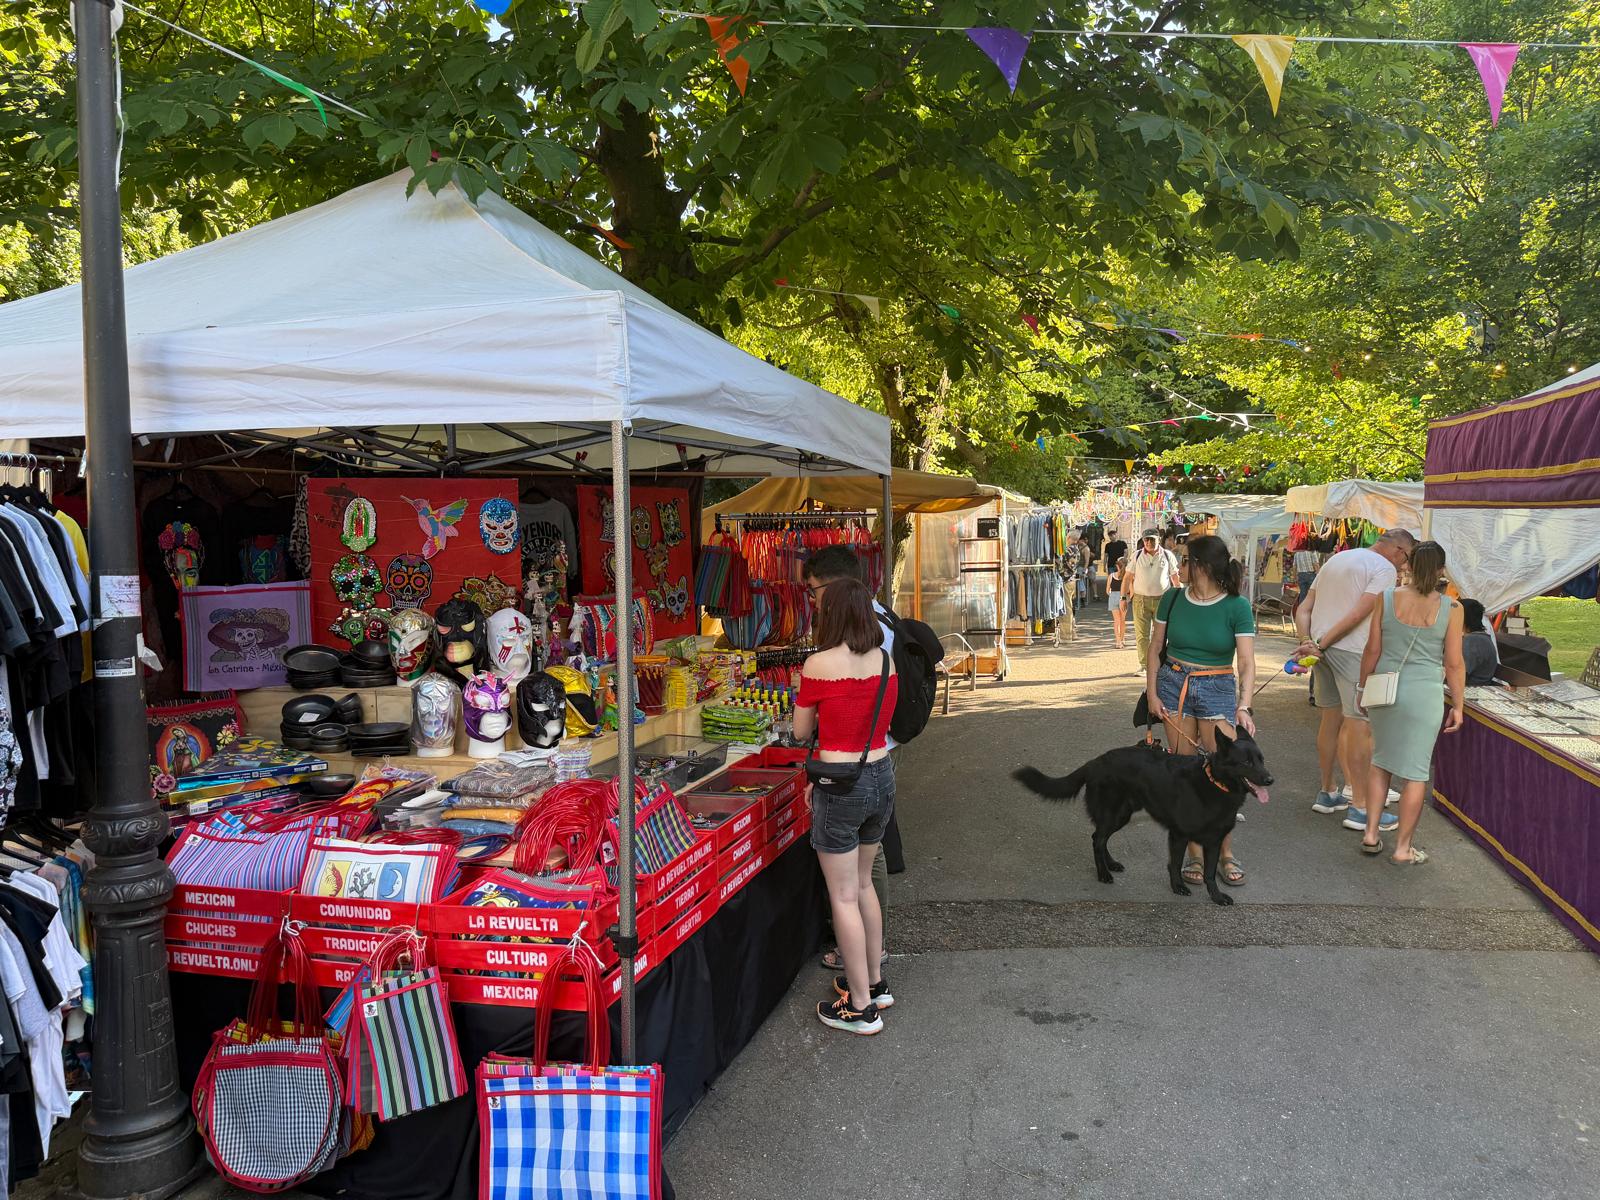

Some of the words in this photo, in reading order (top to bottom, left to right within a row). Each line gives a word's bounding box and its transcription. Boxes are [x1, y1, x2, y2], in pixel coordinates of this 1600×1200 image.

[208, 665, 220, 674] La
[221, 664, 254, 673] Catrina
[732, 839, 752, 861] CHUCHES
[657, 876, 665, 892] LA
[666, 840, 712, 885] REVUELTA.ONLINE
[720, 886, 726, 900] LA
[727, 855, 762, 894] REVUELTA.ONLINE
[185, 891, 236, 907] MEXICAN
[675, 885, 695, 910] TIERRA
[694, 881, 700, 893] Y
[319, 903, 392, 921] COMUNIDAD
[185, 921, 237, 938] CHUCHES
[468, 915, 485, 929] LA
[489, 916, 559, 932] REVUELTA
[676, 910, 702, 941] LIBERTAD
[323, 936, 381, 953] TRADICIÓ
[486, 949, 548, 967] CULTURA
